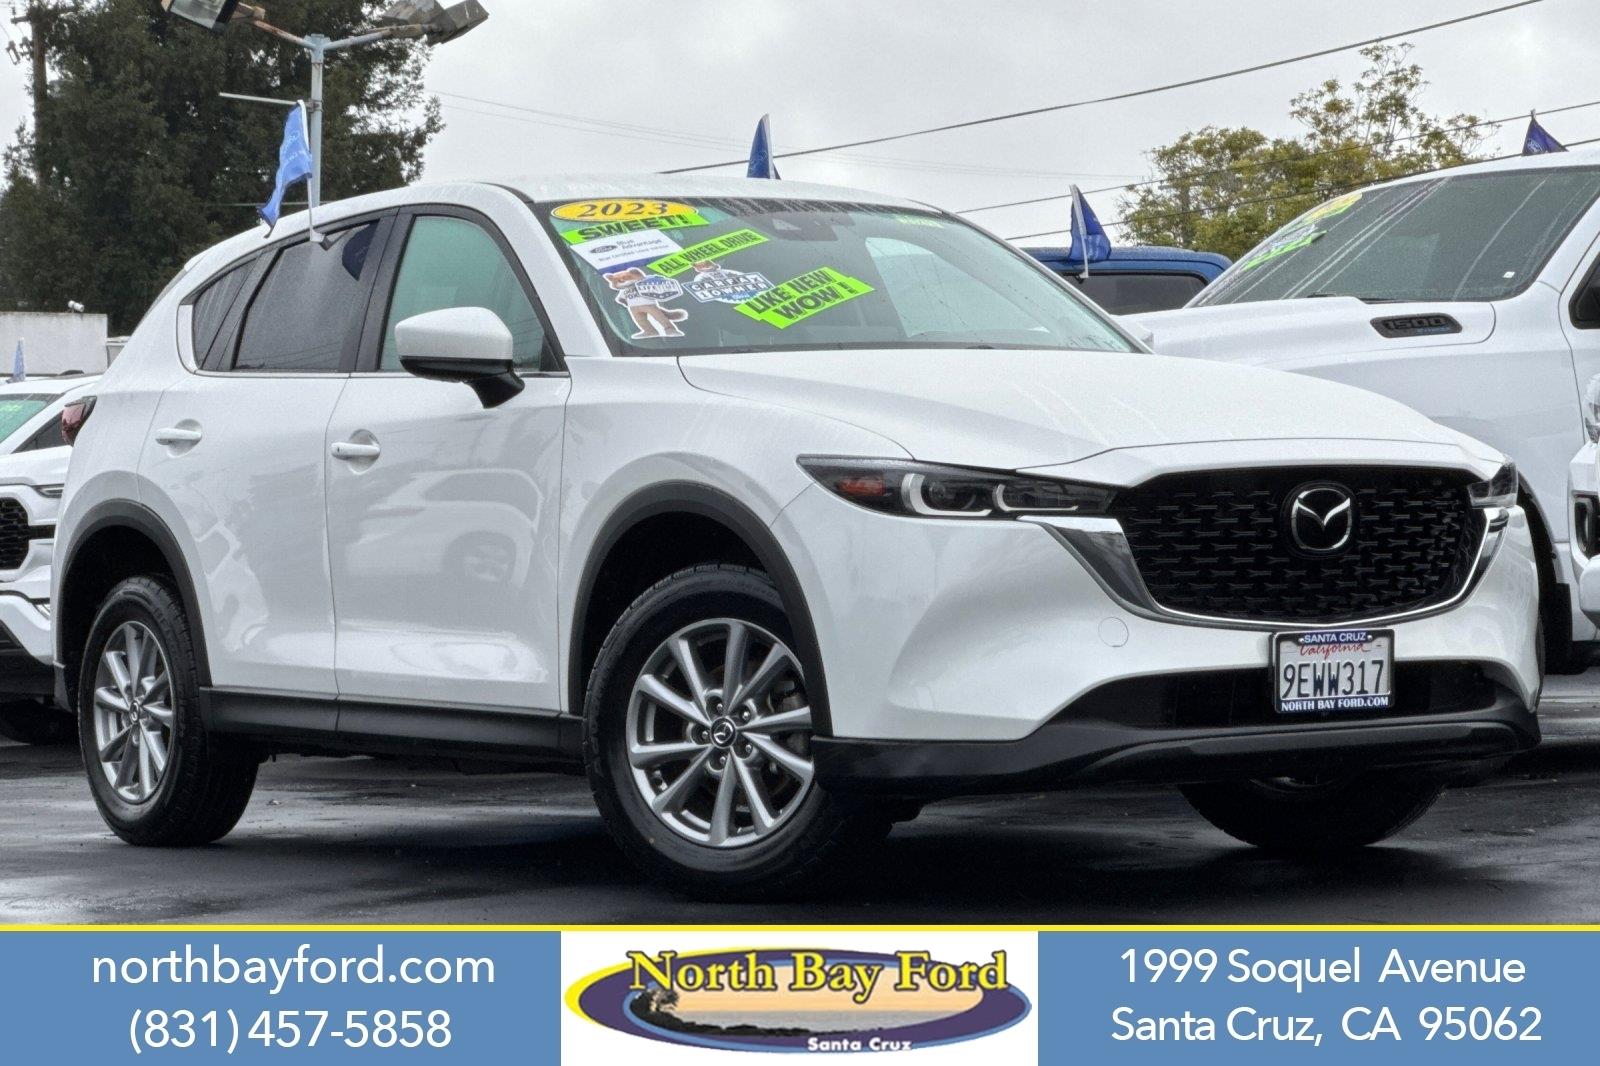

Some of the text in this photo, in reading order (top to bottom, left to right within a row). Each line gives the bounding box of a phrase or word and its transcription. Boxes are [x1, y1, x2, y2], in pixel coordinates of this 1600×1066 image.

[576, 202, 668, 217] 2023
[577, 214, 689, 240] SWEET!
[657, 257, 690, 274] ALL
[679, 242, 729, 262] WHEEL
[718, 231, 762, 248] DRIVE
[691, 274, 767, 291] CARFAX
[744, 270, 838, 314] LIKE NEW
[1381, 317, 1447, 330] 1500
[1304, 631, 1368, 644] SANTA CRUZ
[1300, 642, 1372, 660] California
[1281, 660, 1384, 699] 9EWW317
[1281, 697, 1389, 712] NORTH BAY FORD.COM
